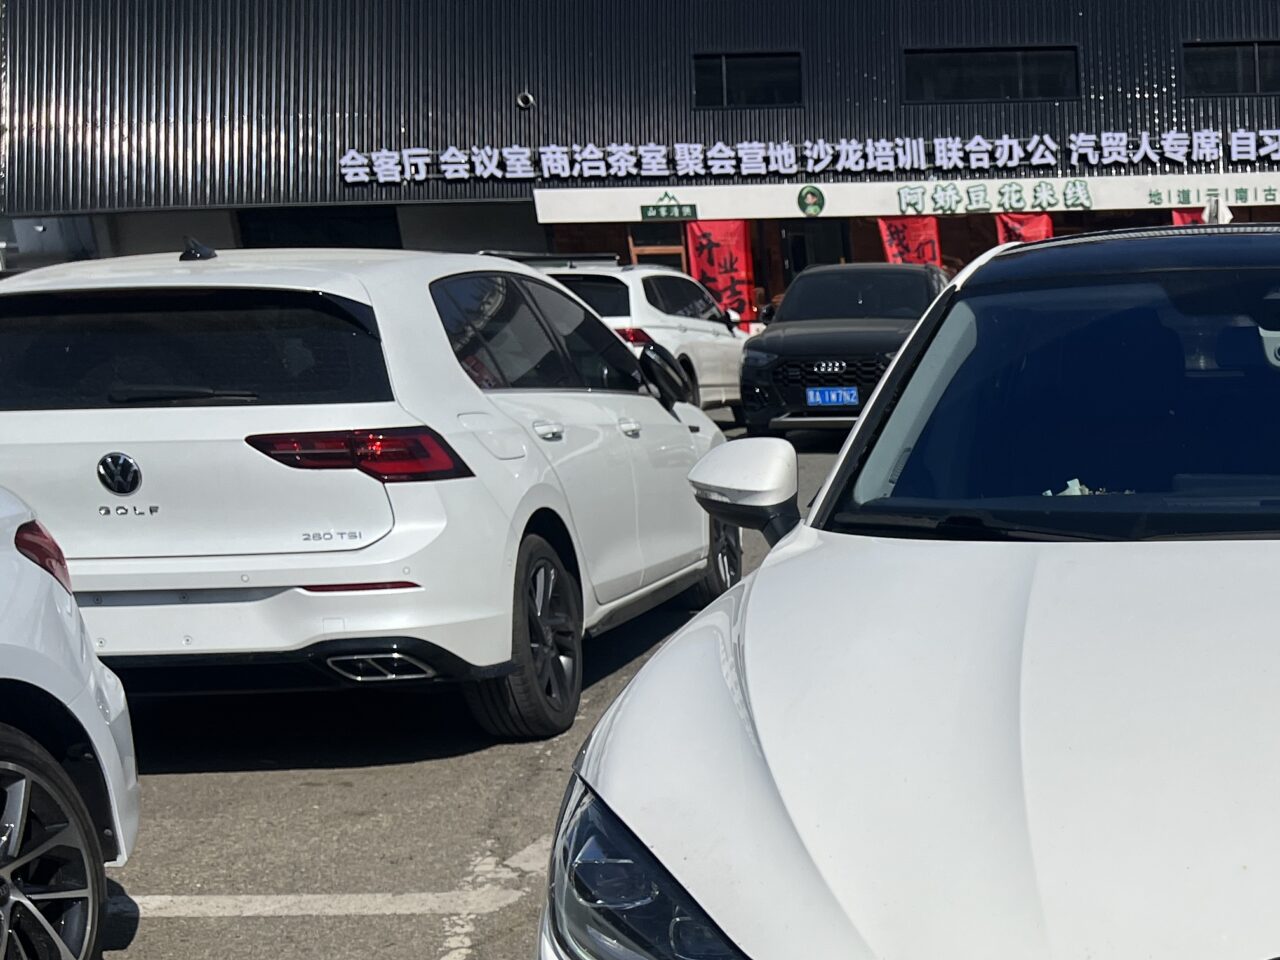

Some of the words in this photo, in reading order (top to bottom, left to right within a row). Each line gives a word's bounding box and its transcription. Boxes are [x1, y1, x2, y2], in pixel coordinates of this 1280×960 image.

[339, 148, 431, 184] 会客厅
[439, 146, 535, 180] 会议室
[539, 142, 670, 179] 商洽茶室
[674, 140, 798, 177] 聚会营地
[803, 136, 926, 173] 沙龙培训
[933, 133, 1058, 170] 联合办公
[1069, 129, 1221, 165] 汽贸人专席
[897, 179, 1093, 214] 阿娇豆花米线
[99, 505, 159, 515] GOLF
[336, 531, 362, 540] TSI
